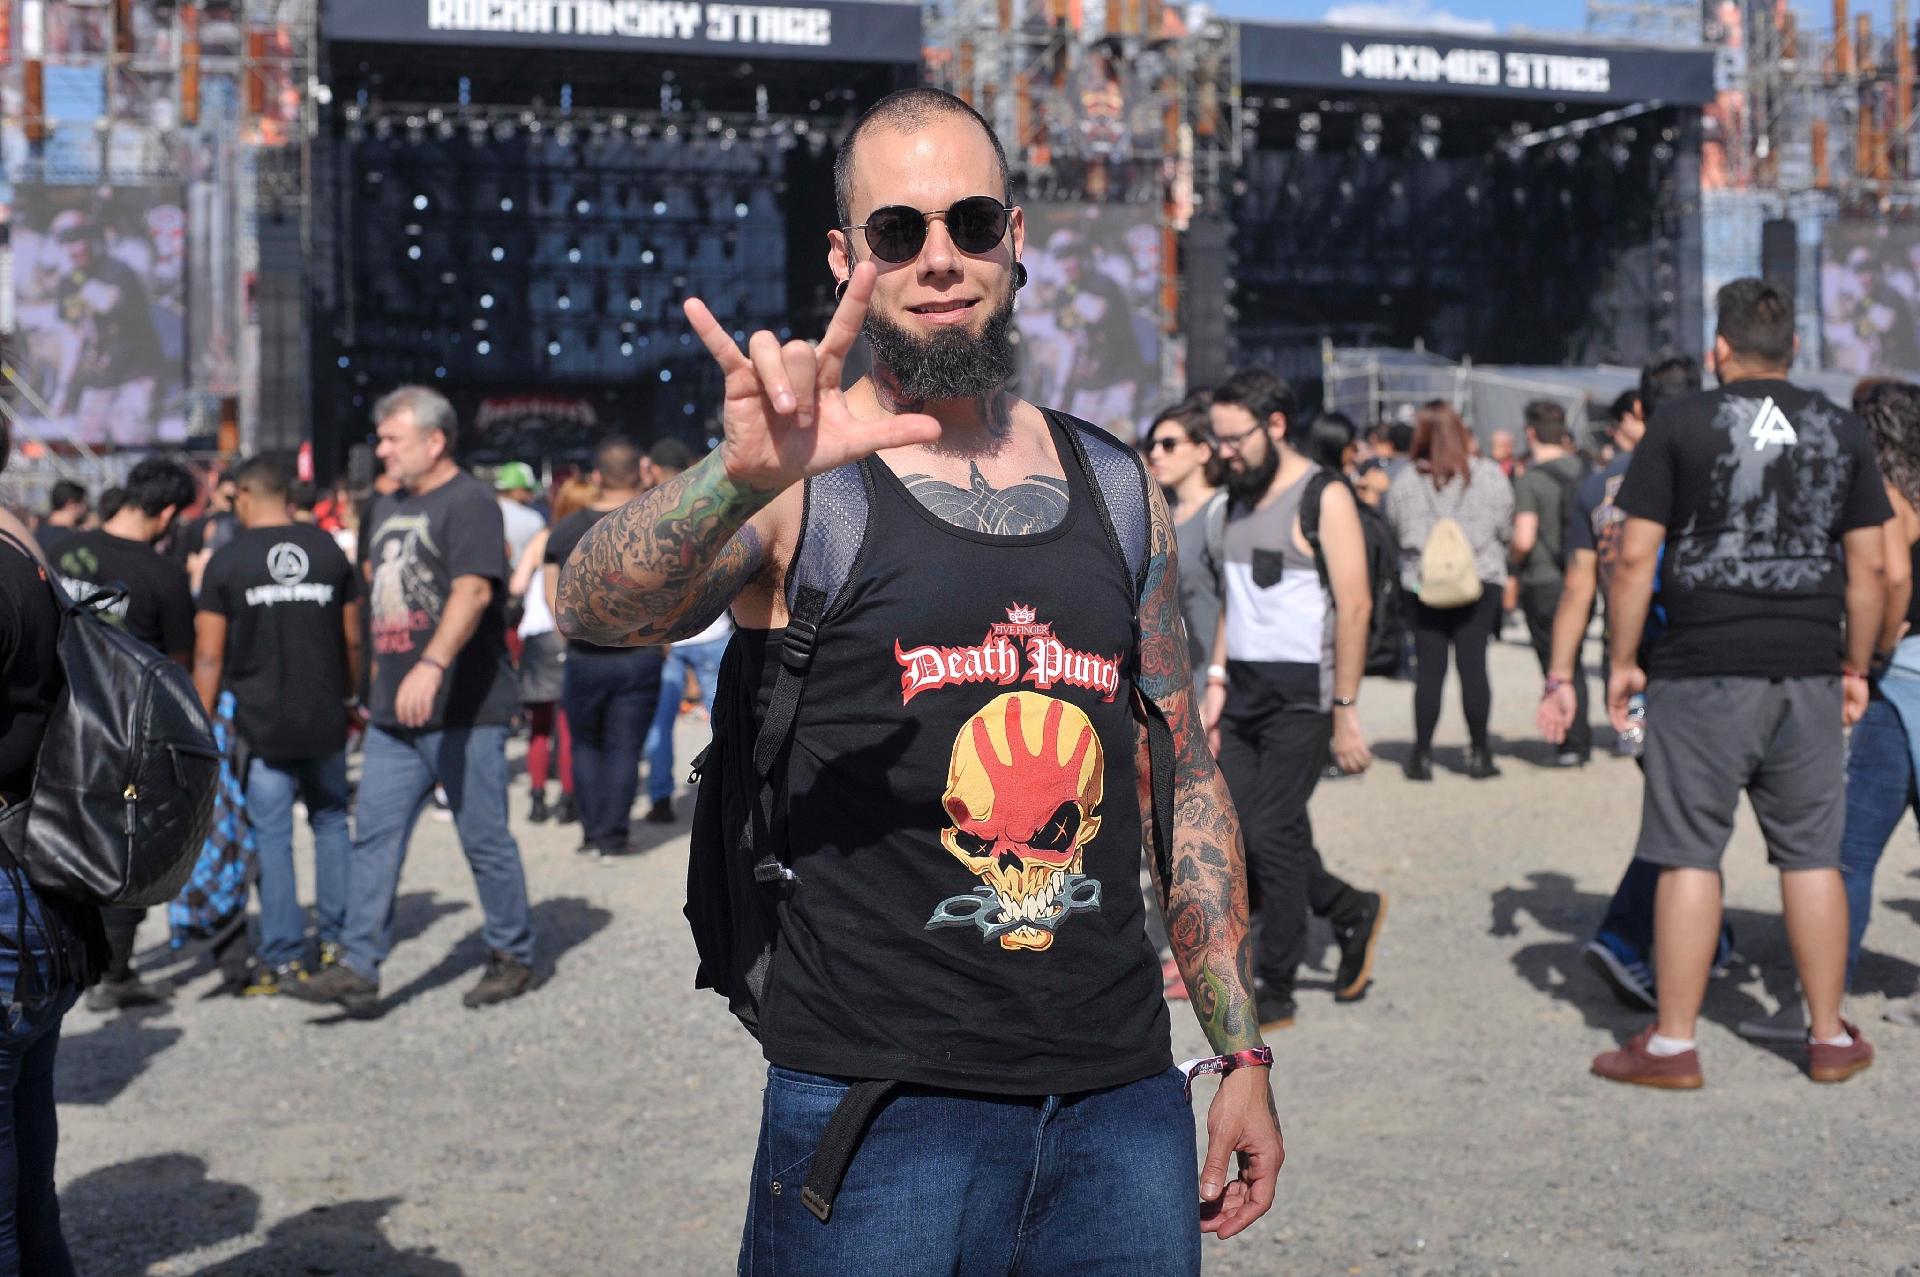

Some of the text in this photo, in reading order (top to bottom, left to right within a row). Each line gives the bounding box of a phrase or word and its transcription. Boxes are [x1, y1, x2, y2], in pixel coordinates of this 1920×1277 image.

[427, 0, 832, 46] ROCKATANSKY STAGE
[1340, 42, 1610, 92] MAXIMUS STAGE
[994, 625, 1049, 635] FIVE FINGER
[900, 638, 1120, 699] Death Punch
